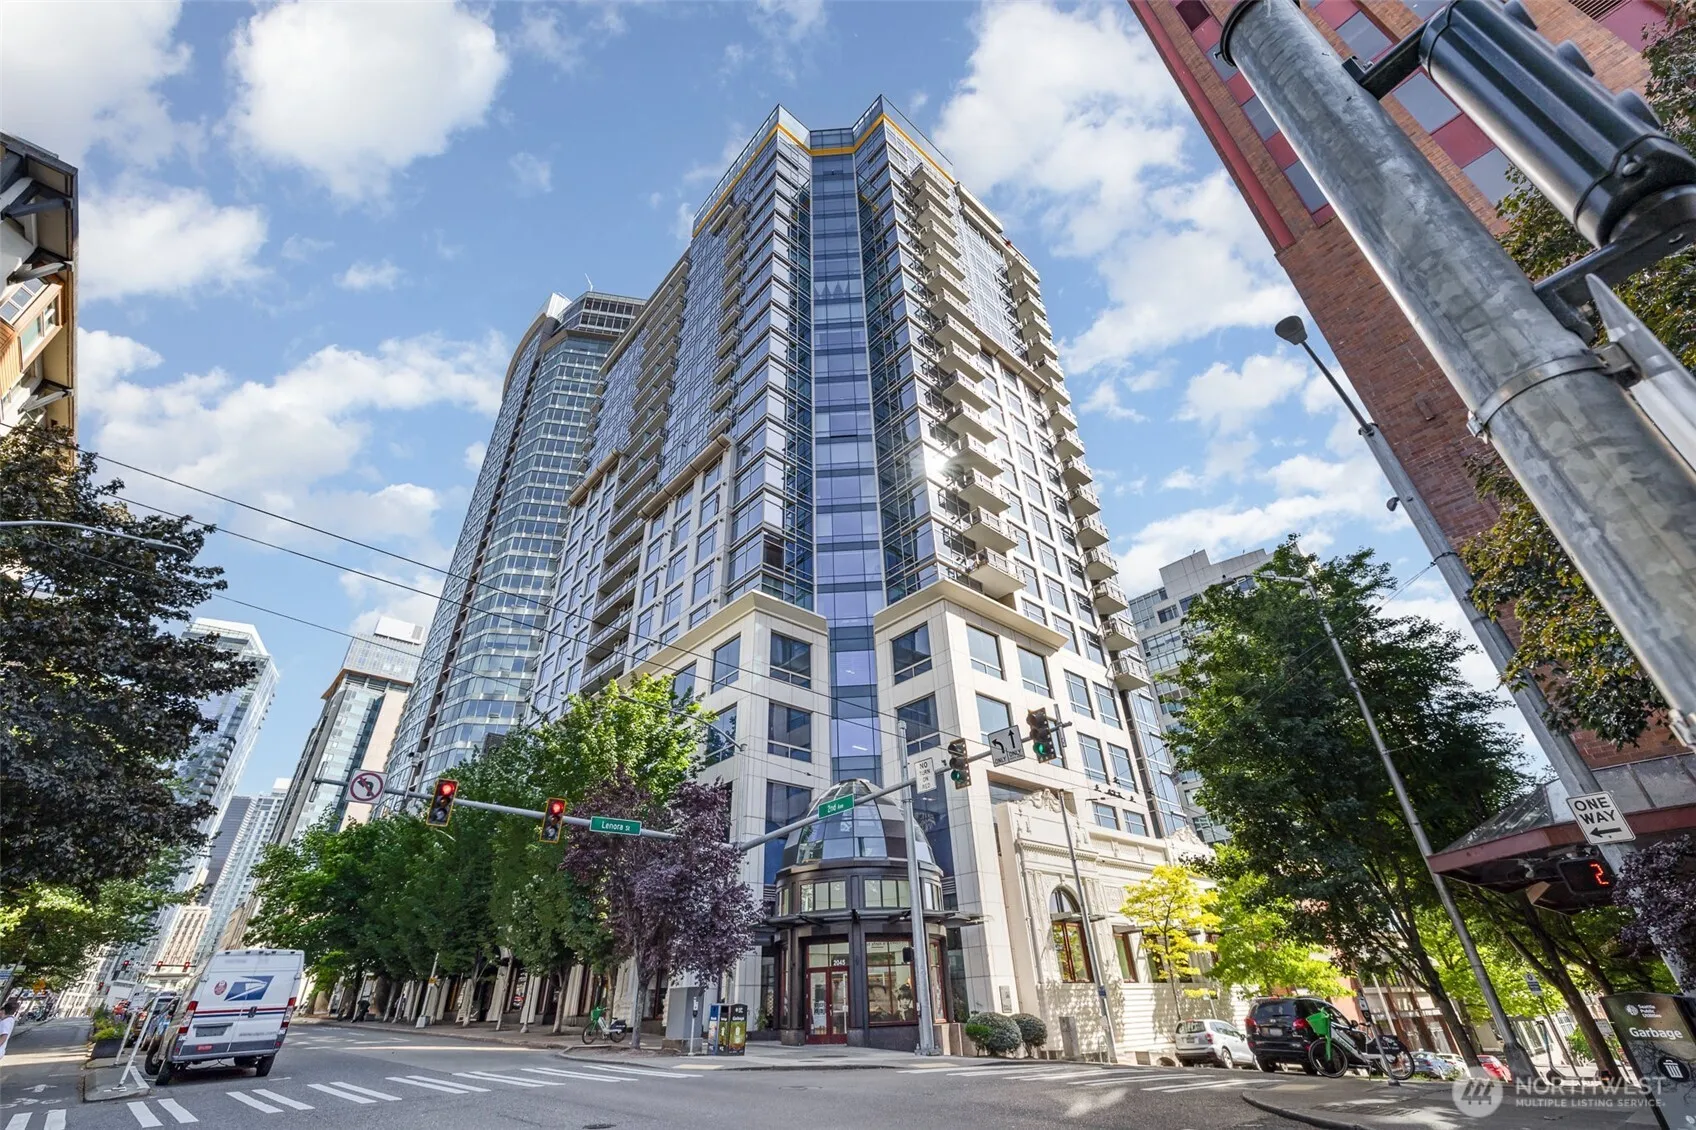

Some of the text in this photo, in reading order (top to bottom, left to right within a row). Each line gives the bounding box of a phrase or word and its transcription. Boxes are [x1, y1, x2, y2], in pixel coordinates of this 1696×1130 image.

[1009, 748, 1022, 757] ONLY
[919, 761, 928, 769] NO
[995, 756, 1006, 764] ONLY
[827, 803, 837, 813] 2nd
[1574, 797, 1610, 811] ONE
[1580, 809, 1616, 825] WAY
[601, 821, 624, 831] Lenora
[1590, 863, 1609, 885] 2
[1629, 1027, 1683, 1040] Garbage
